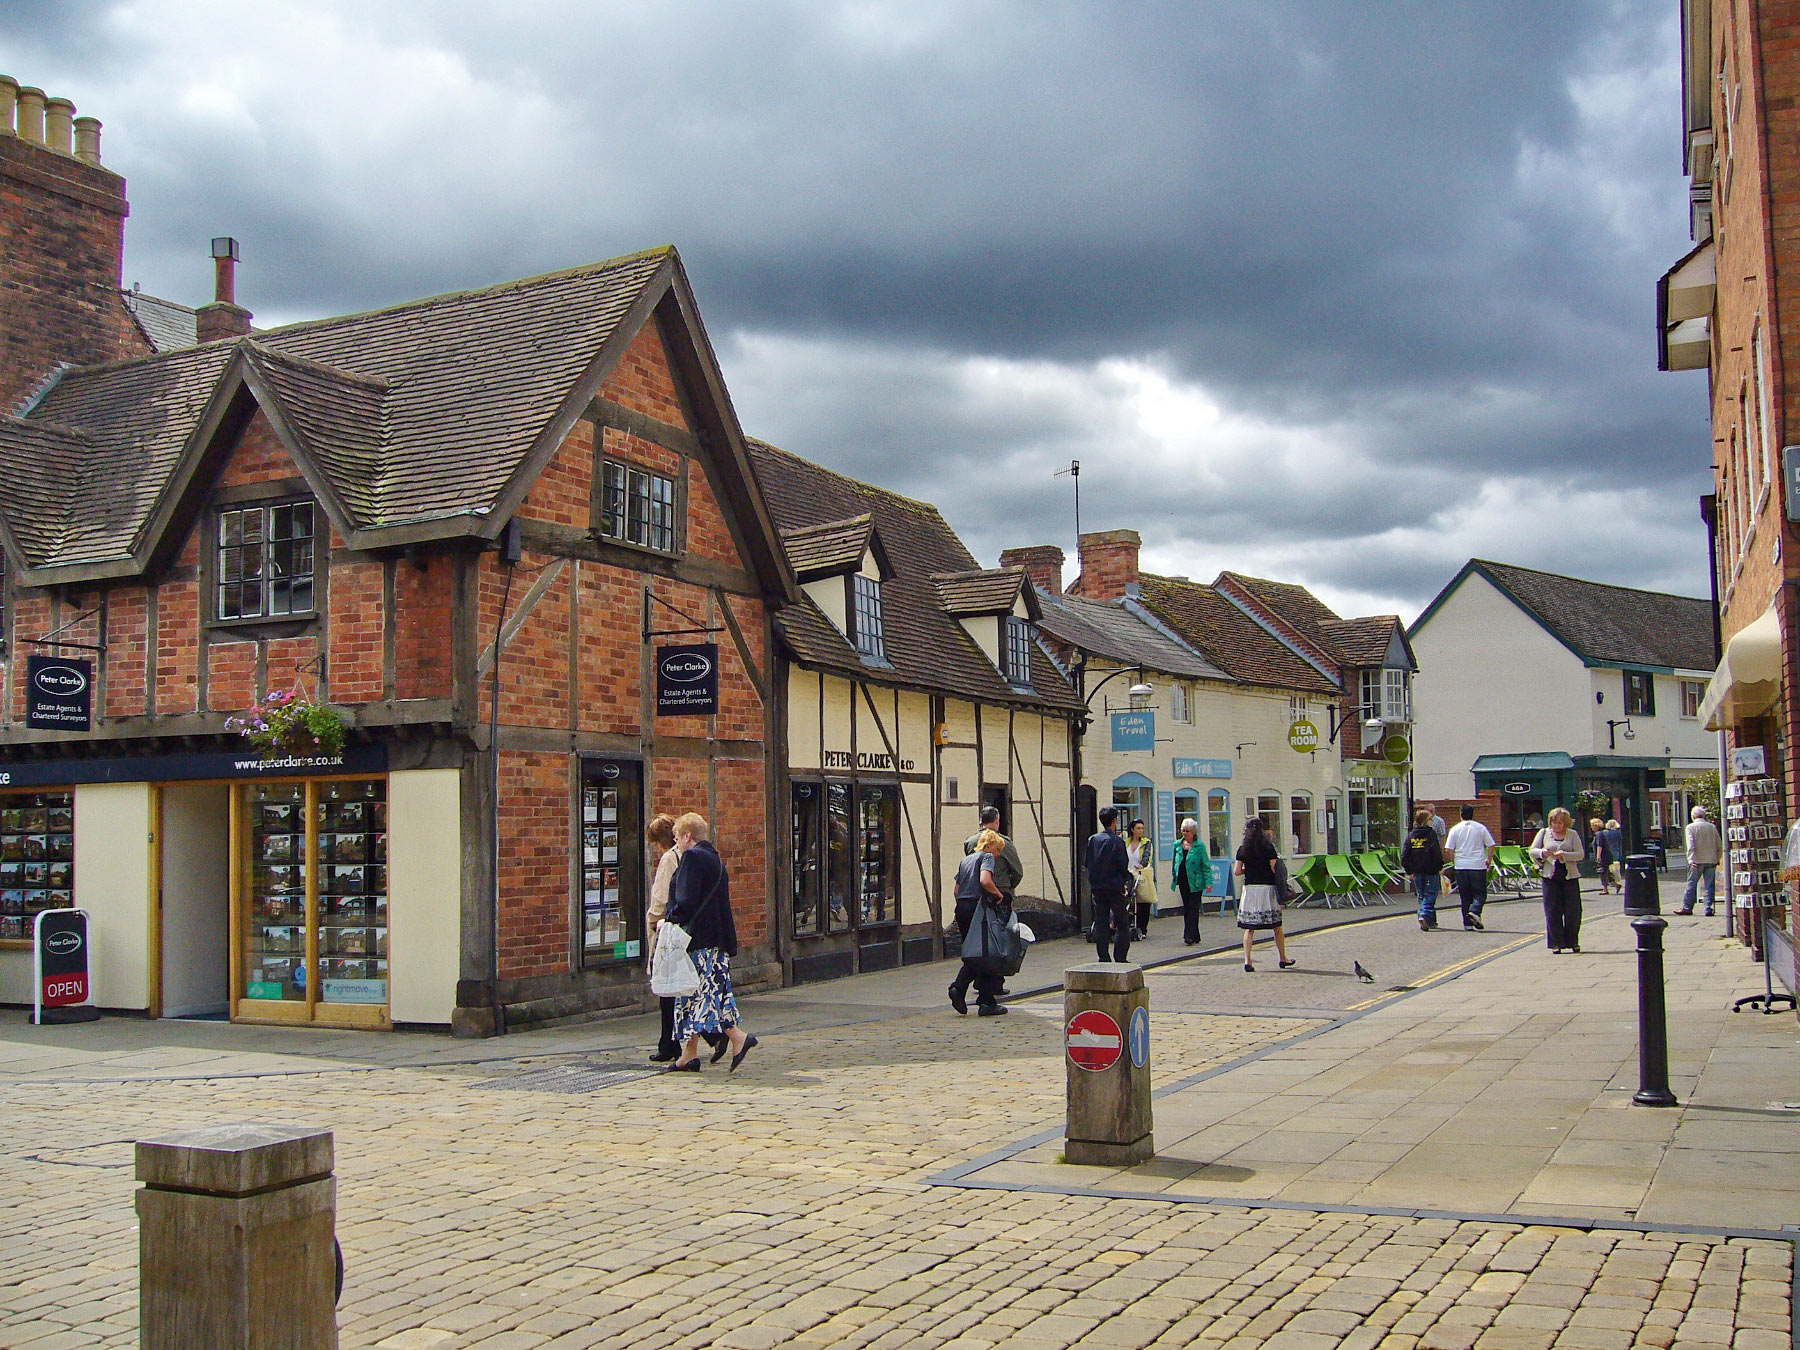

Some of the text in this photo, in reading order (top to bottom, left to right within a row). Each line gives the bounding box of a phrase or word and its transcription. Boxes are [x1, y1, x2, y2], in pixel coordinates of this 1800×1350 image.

[684, 663, 706, 671] Clarke
[41, 675, 81, 686] Peter Clarke
[664, 687, 707, 698] Estate Agents &
[686, 697, 712, 706] Surveyors
[37, 703, 82, 713] Estate Agents &
[32, 712, 87, 722] Chartered Surveyors
[1120, 716, 1144, 726] Eden
[1118, 725, 1147, 736] Travel
[1294, 725, 1313, 735] TEA
[1290, 735, 1317, 746] ROOM
[824, 750, 914, 770] PETER CLARKE & CO
[1175, 761, 1193, 775] Eden
[49, 938, 78, 947] Peter Clarke
[47, 980, 83, 998] OPEN
